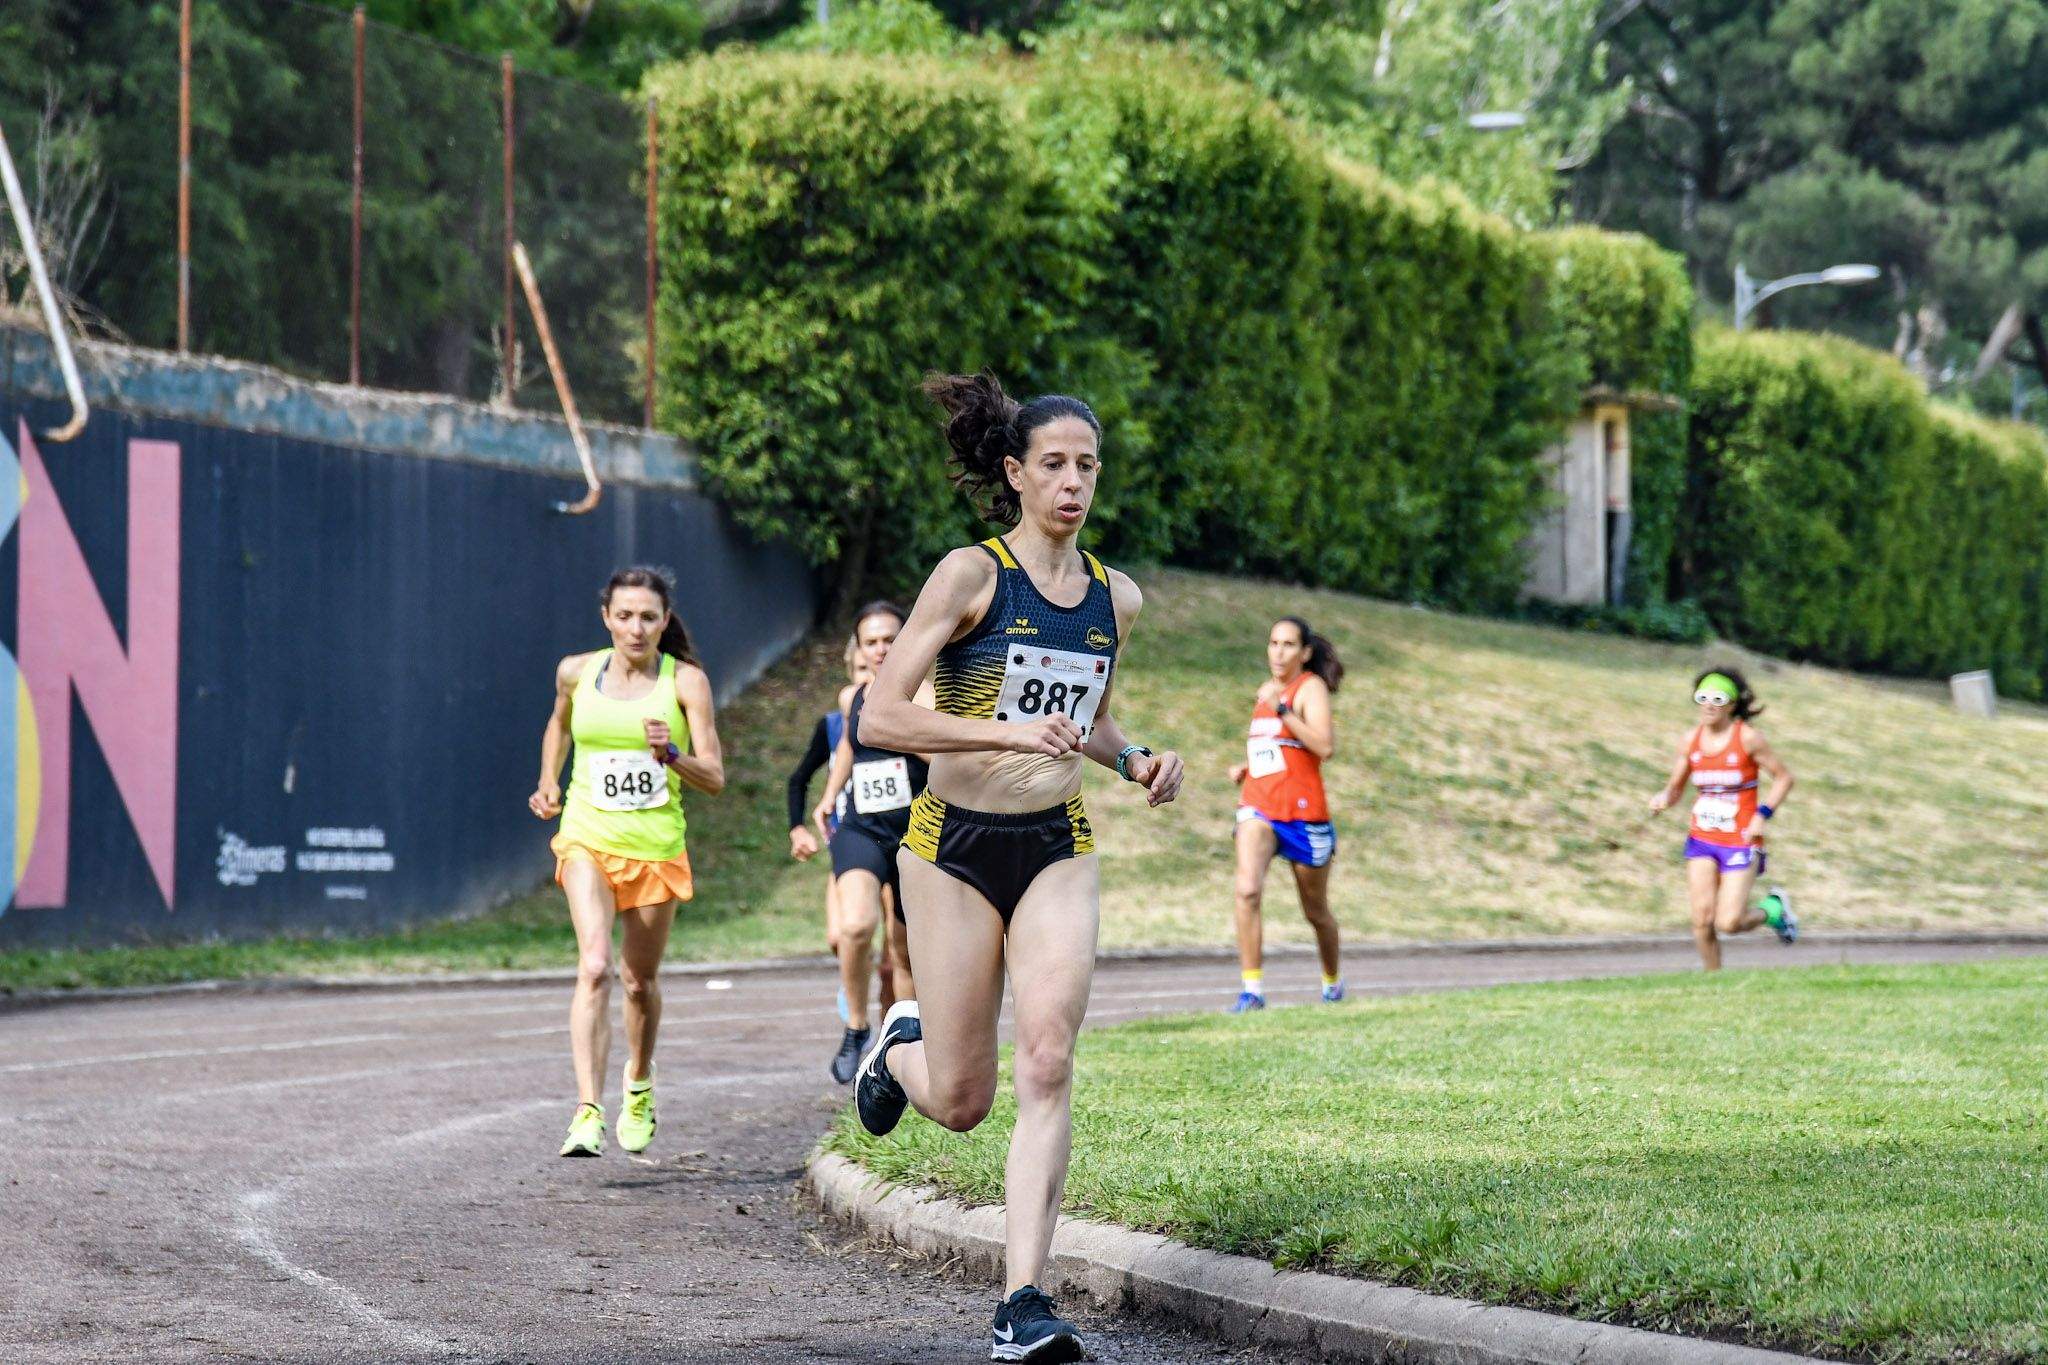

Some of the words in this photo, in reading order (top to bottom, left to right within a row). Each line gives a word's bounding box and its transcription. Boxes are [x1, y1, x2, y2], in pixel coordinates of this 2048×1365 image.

[1005, 627, 1038, 635] amura
[1018, 679, 1089, 721] 887
[604, 771, 652, 797] 848
